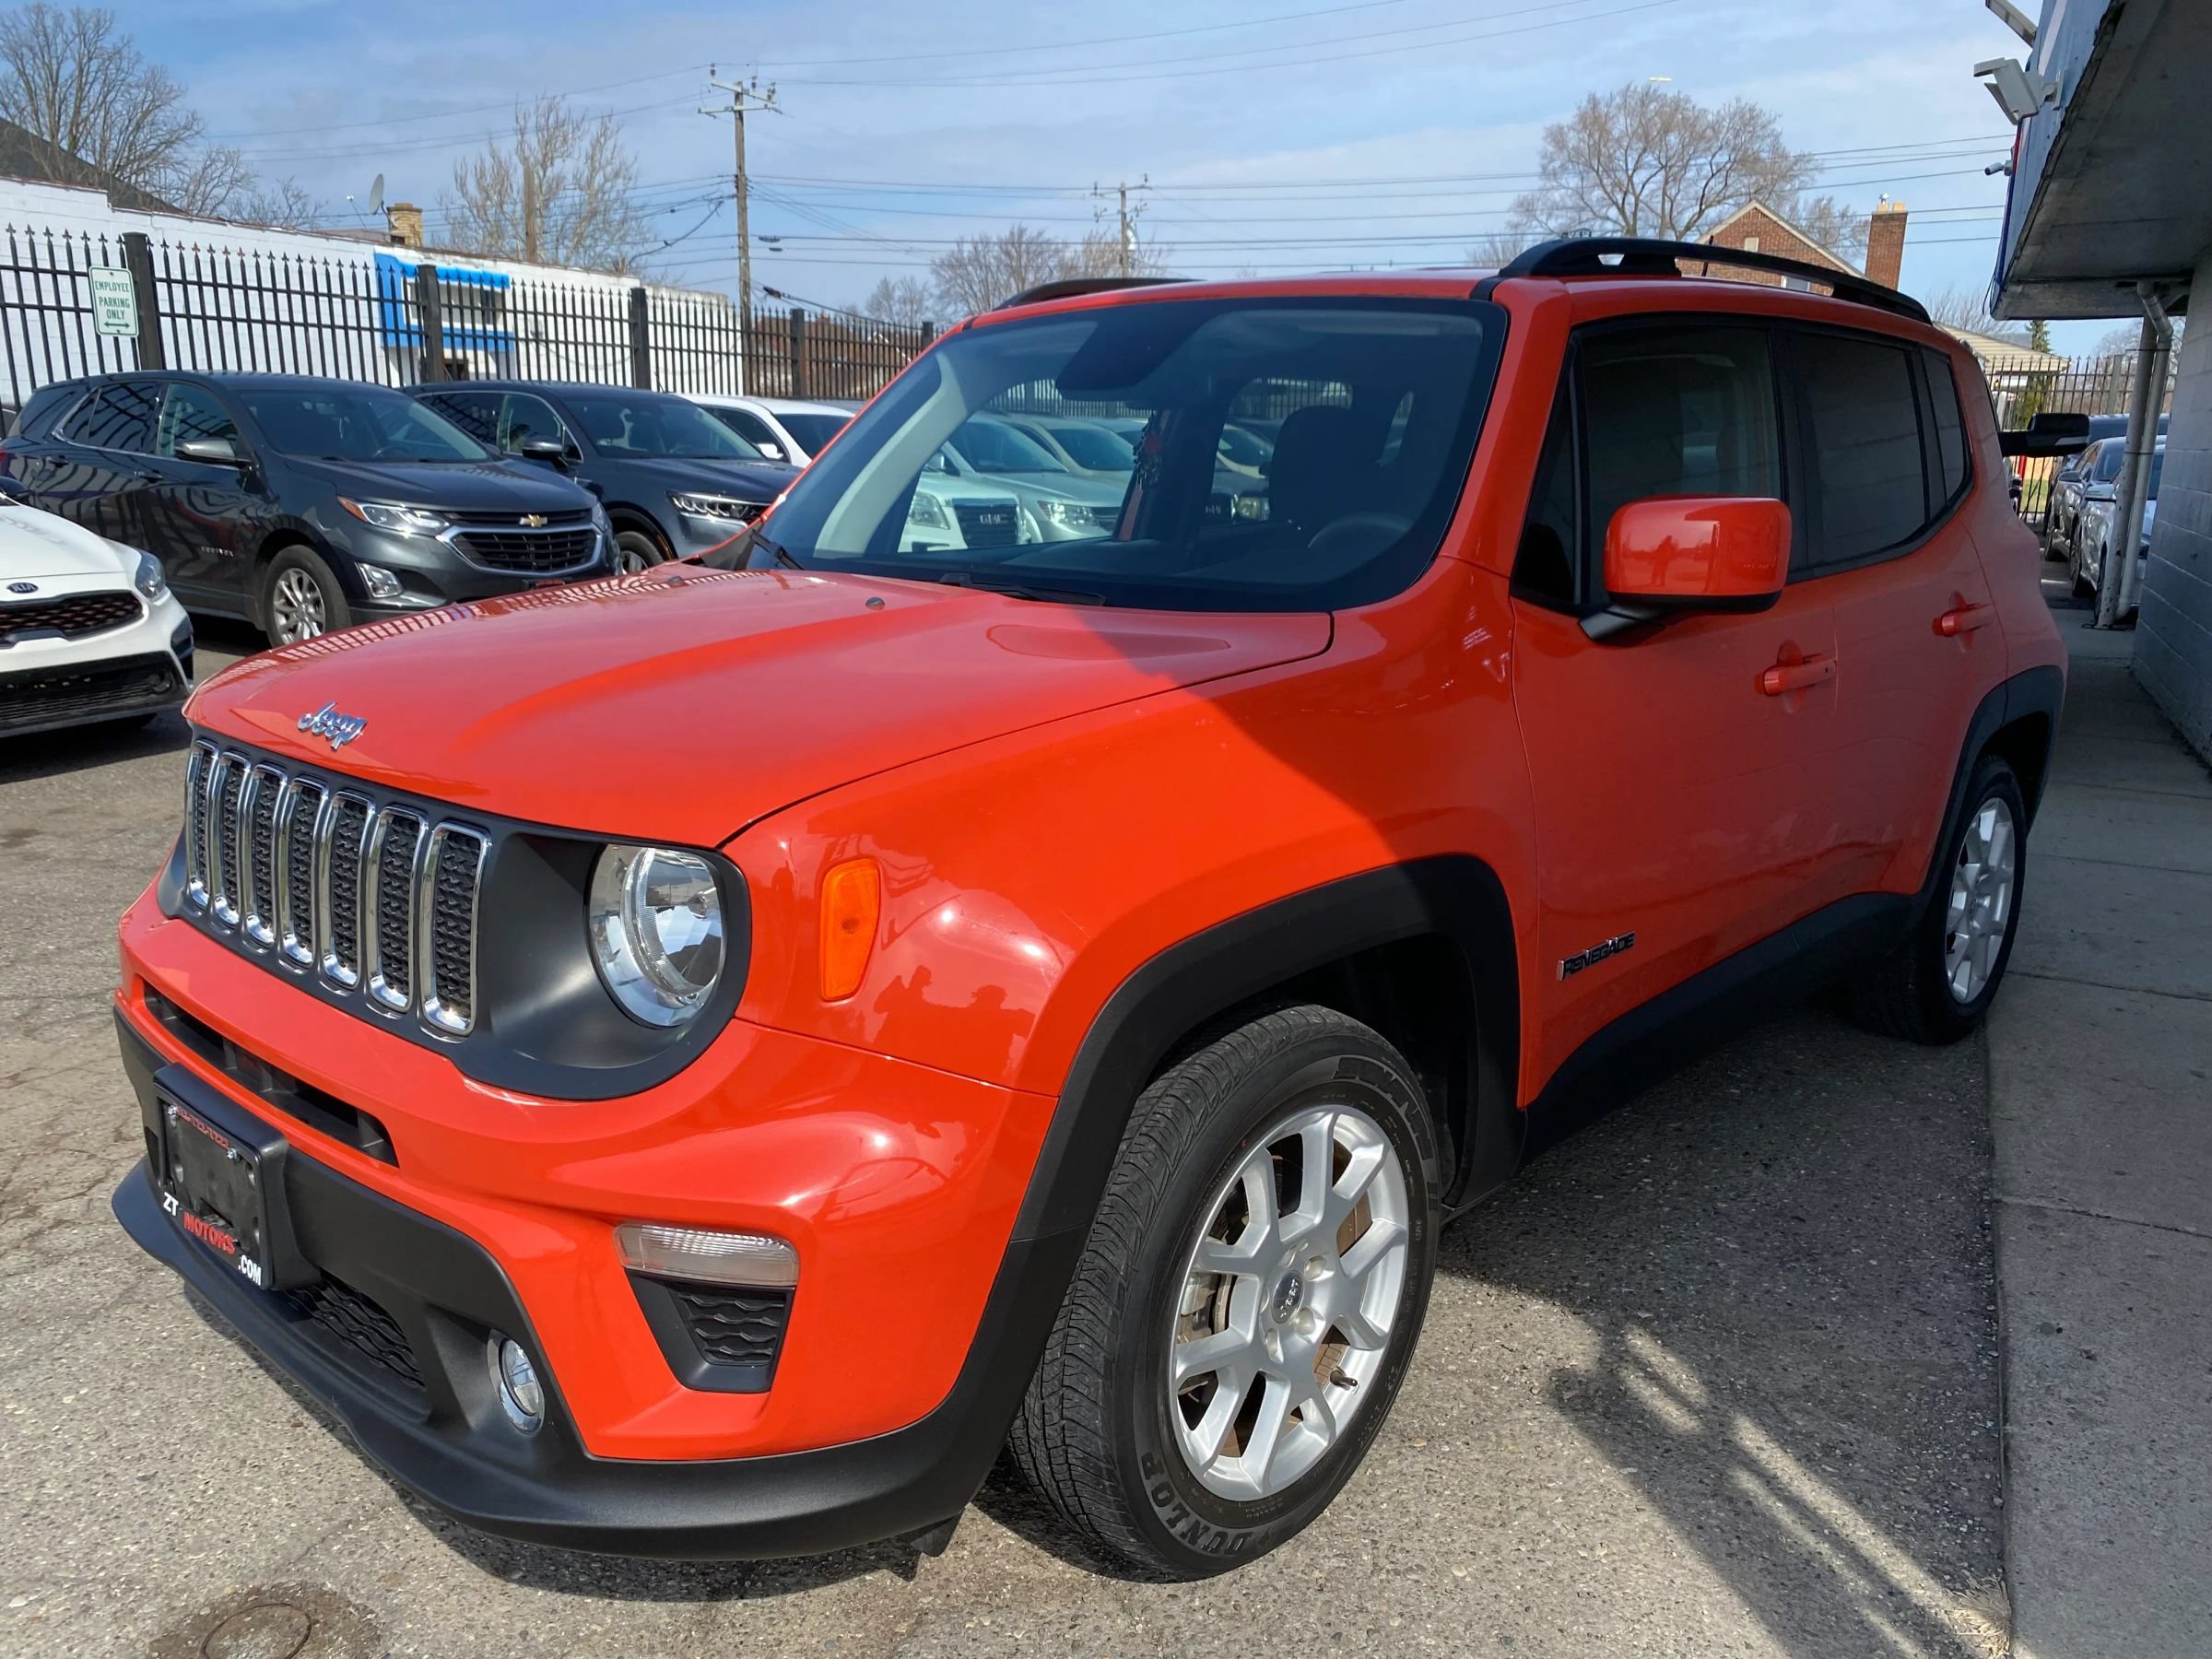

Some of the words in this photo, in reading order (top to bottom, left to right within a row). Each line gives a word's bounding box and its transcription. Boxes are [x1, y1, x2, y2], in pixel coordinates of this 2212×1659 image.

[94, 280, 130, 292] EMPLOYEE
[99, 297, 131, 309] PARKING
[106, 309, 125, 320] ONLY
[9, 582, 37, 593] KIA
[297, 700, 368, 751] Jeep
[1557, 930, 1637, 982] RENEGADE
[163, 1192, 180, 1216] ZT
[183, 1211, 236, 1255] MOTORS
[1140, 1452, 1254, 1556] DUNLOP
